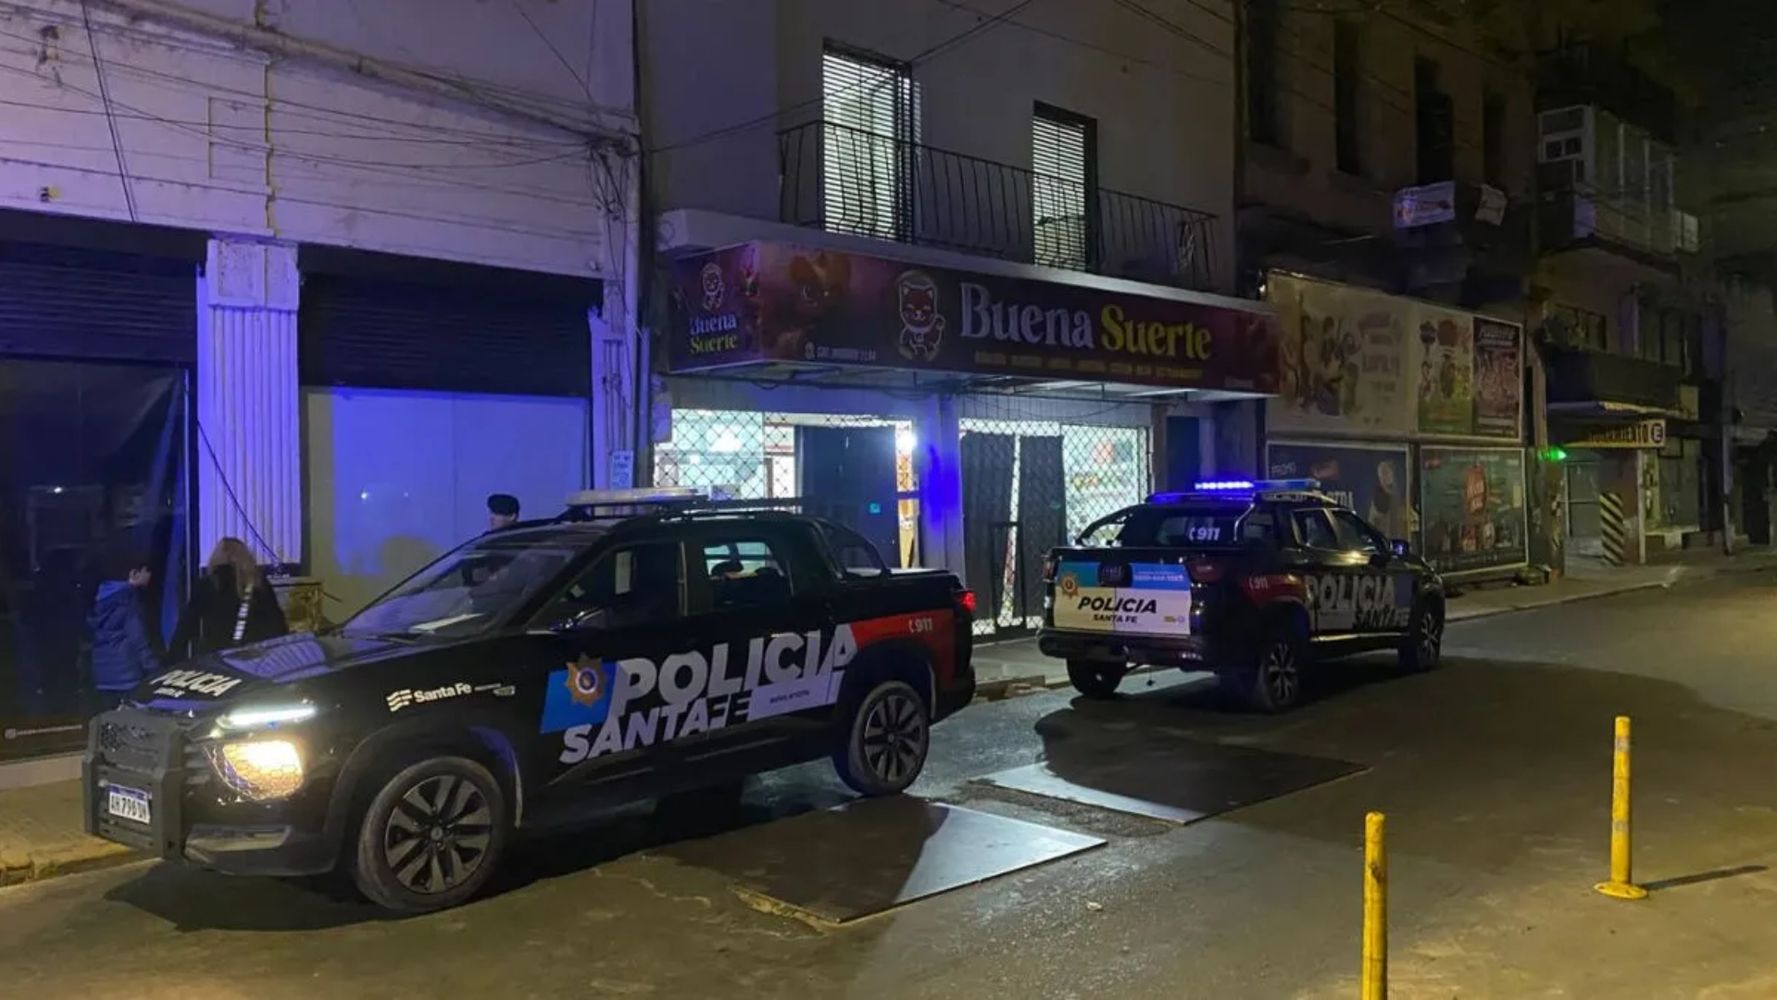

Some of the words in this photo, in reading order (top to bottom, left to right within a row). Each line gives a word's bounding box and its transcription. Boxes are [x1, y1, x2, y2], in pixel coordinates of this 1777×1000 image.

[961, 281, 1094, 350] Buena
[1100, 303, 1212, 361] Suerte
[689, 333, 738, 354] Suerte
[1197, 527, 1221, 541] 911
[1254, 576, 1269, 590] 911
[1304, 574, 1396, 609] POLICIA
[1078, 596, 1157, 614] POLICIA
[914, 616, 933, 633] 911
[1093, 614, 1123, 623] SANTA
[1125, 615, 1138, 624] FE
[606, 622, 859, 718] POLICIA
[149, 669, 243, 697] POLICIA
[414, 686, 456, 703] Santa
[455, 682, 473, 696] Fe
[558, 696, 710, 766] SANTA
